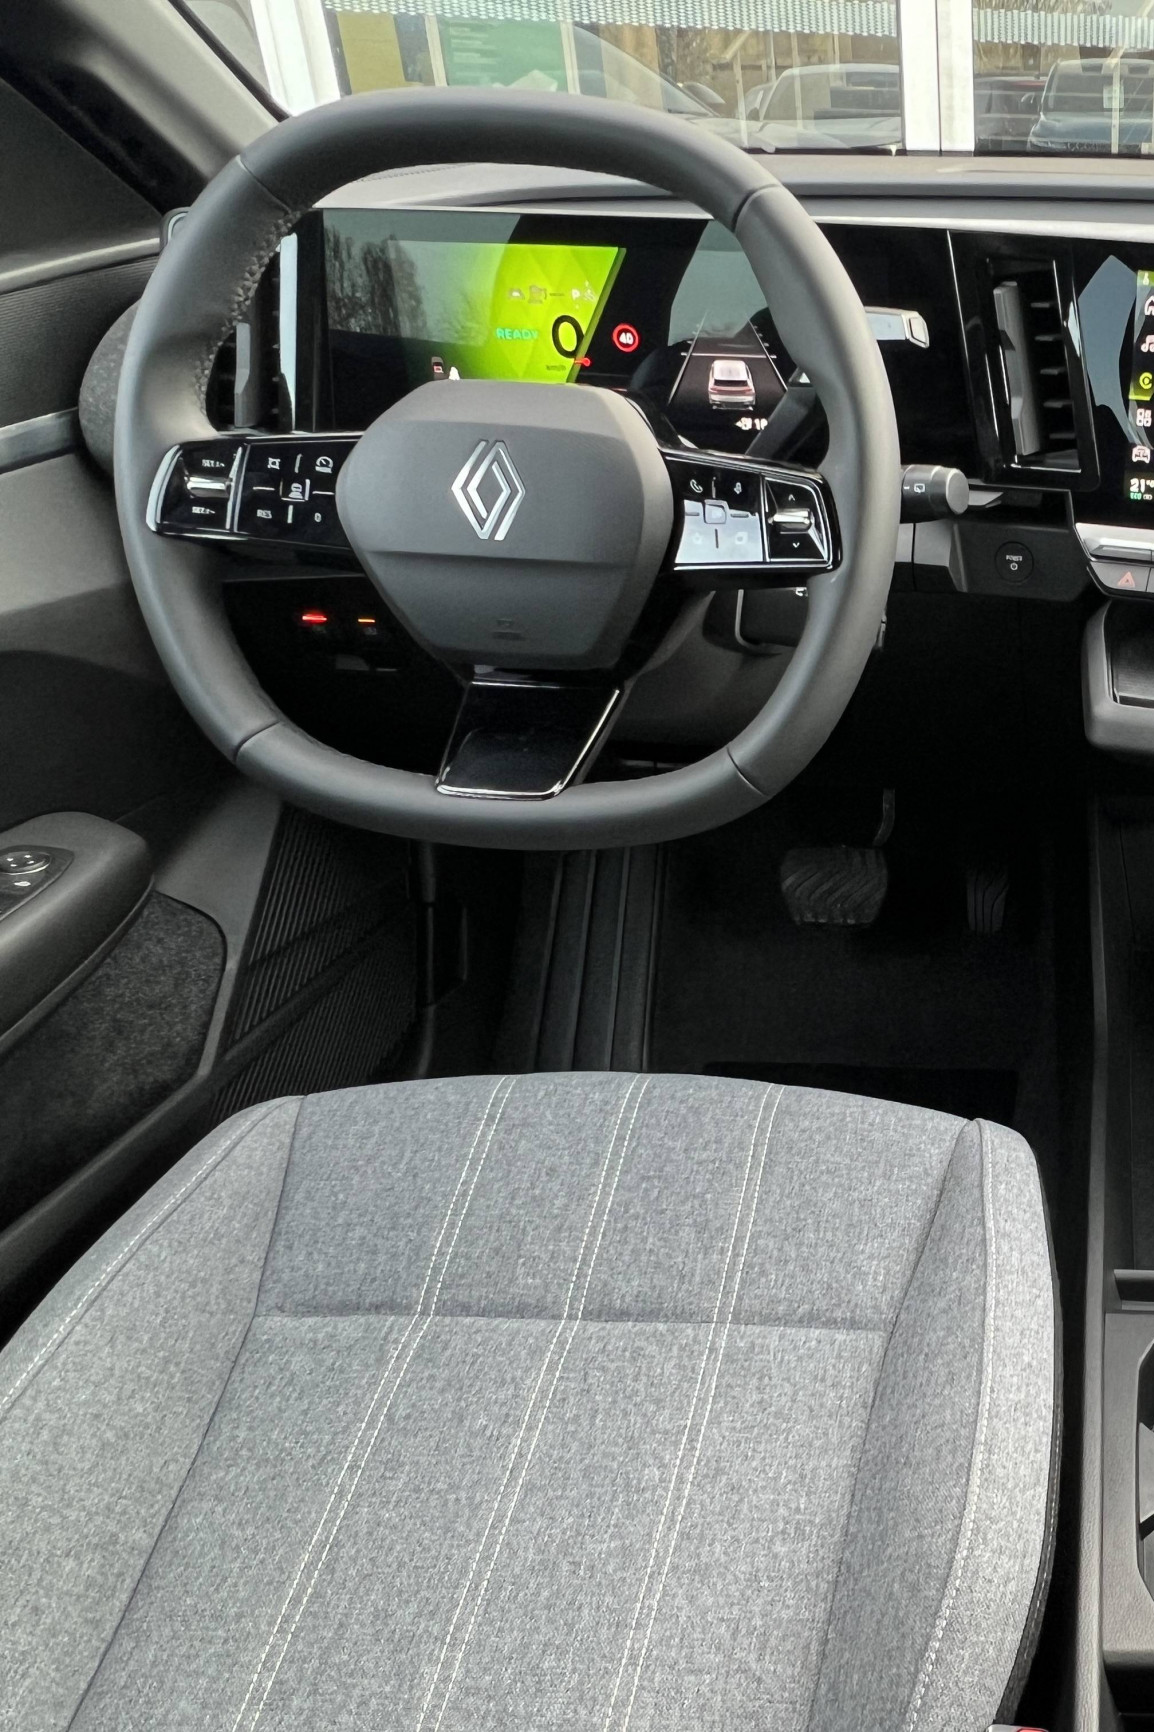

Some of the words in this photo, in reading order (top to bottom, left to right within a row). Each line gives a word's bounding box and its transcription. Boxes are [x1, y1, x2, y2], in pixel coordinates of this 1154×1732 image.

[495, 327, 538, 340] READY
[551, 314, 585, 359] 0
[619, 331, 634, 345] 40
